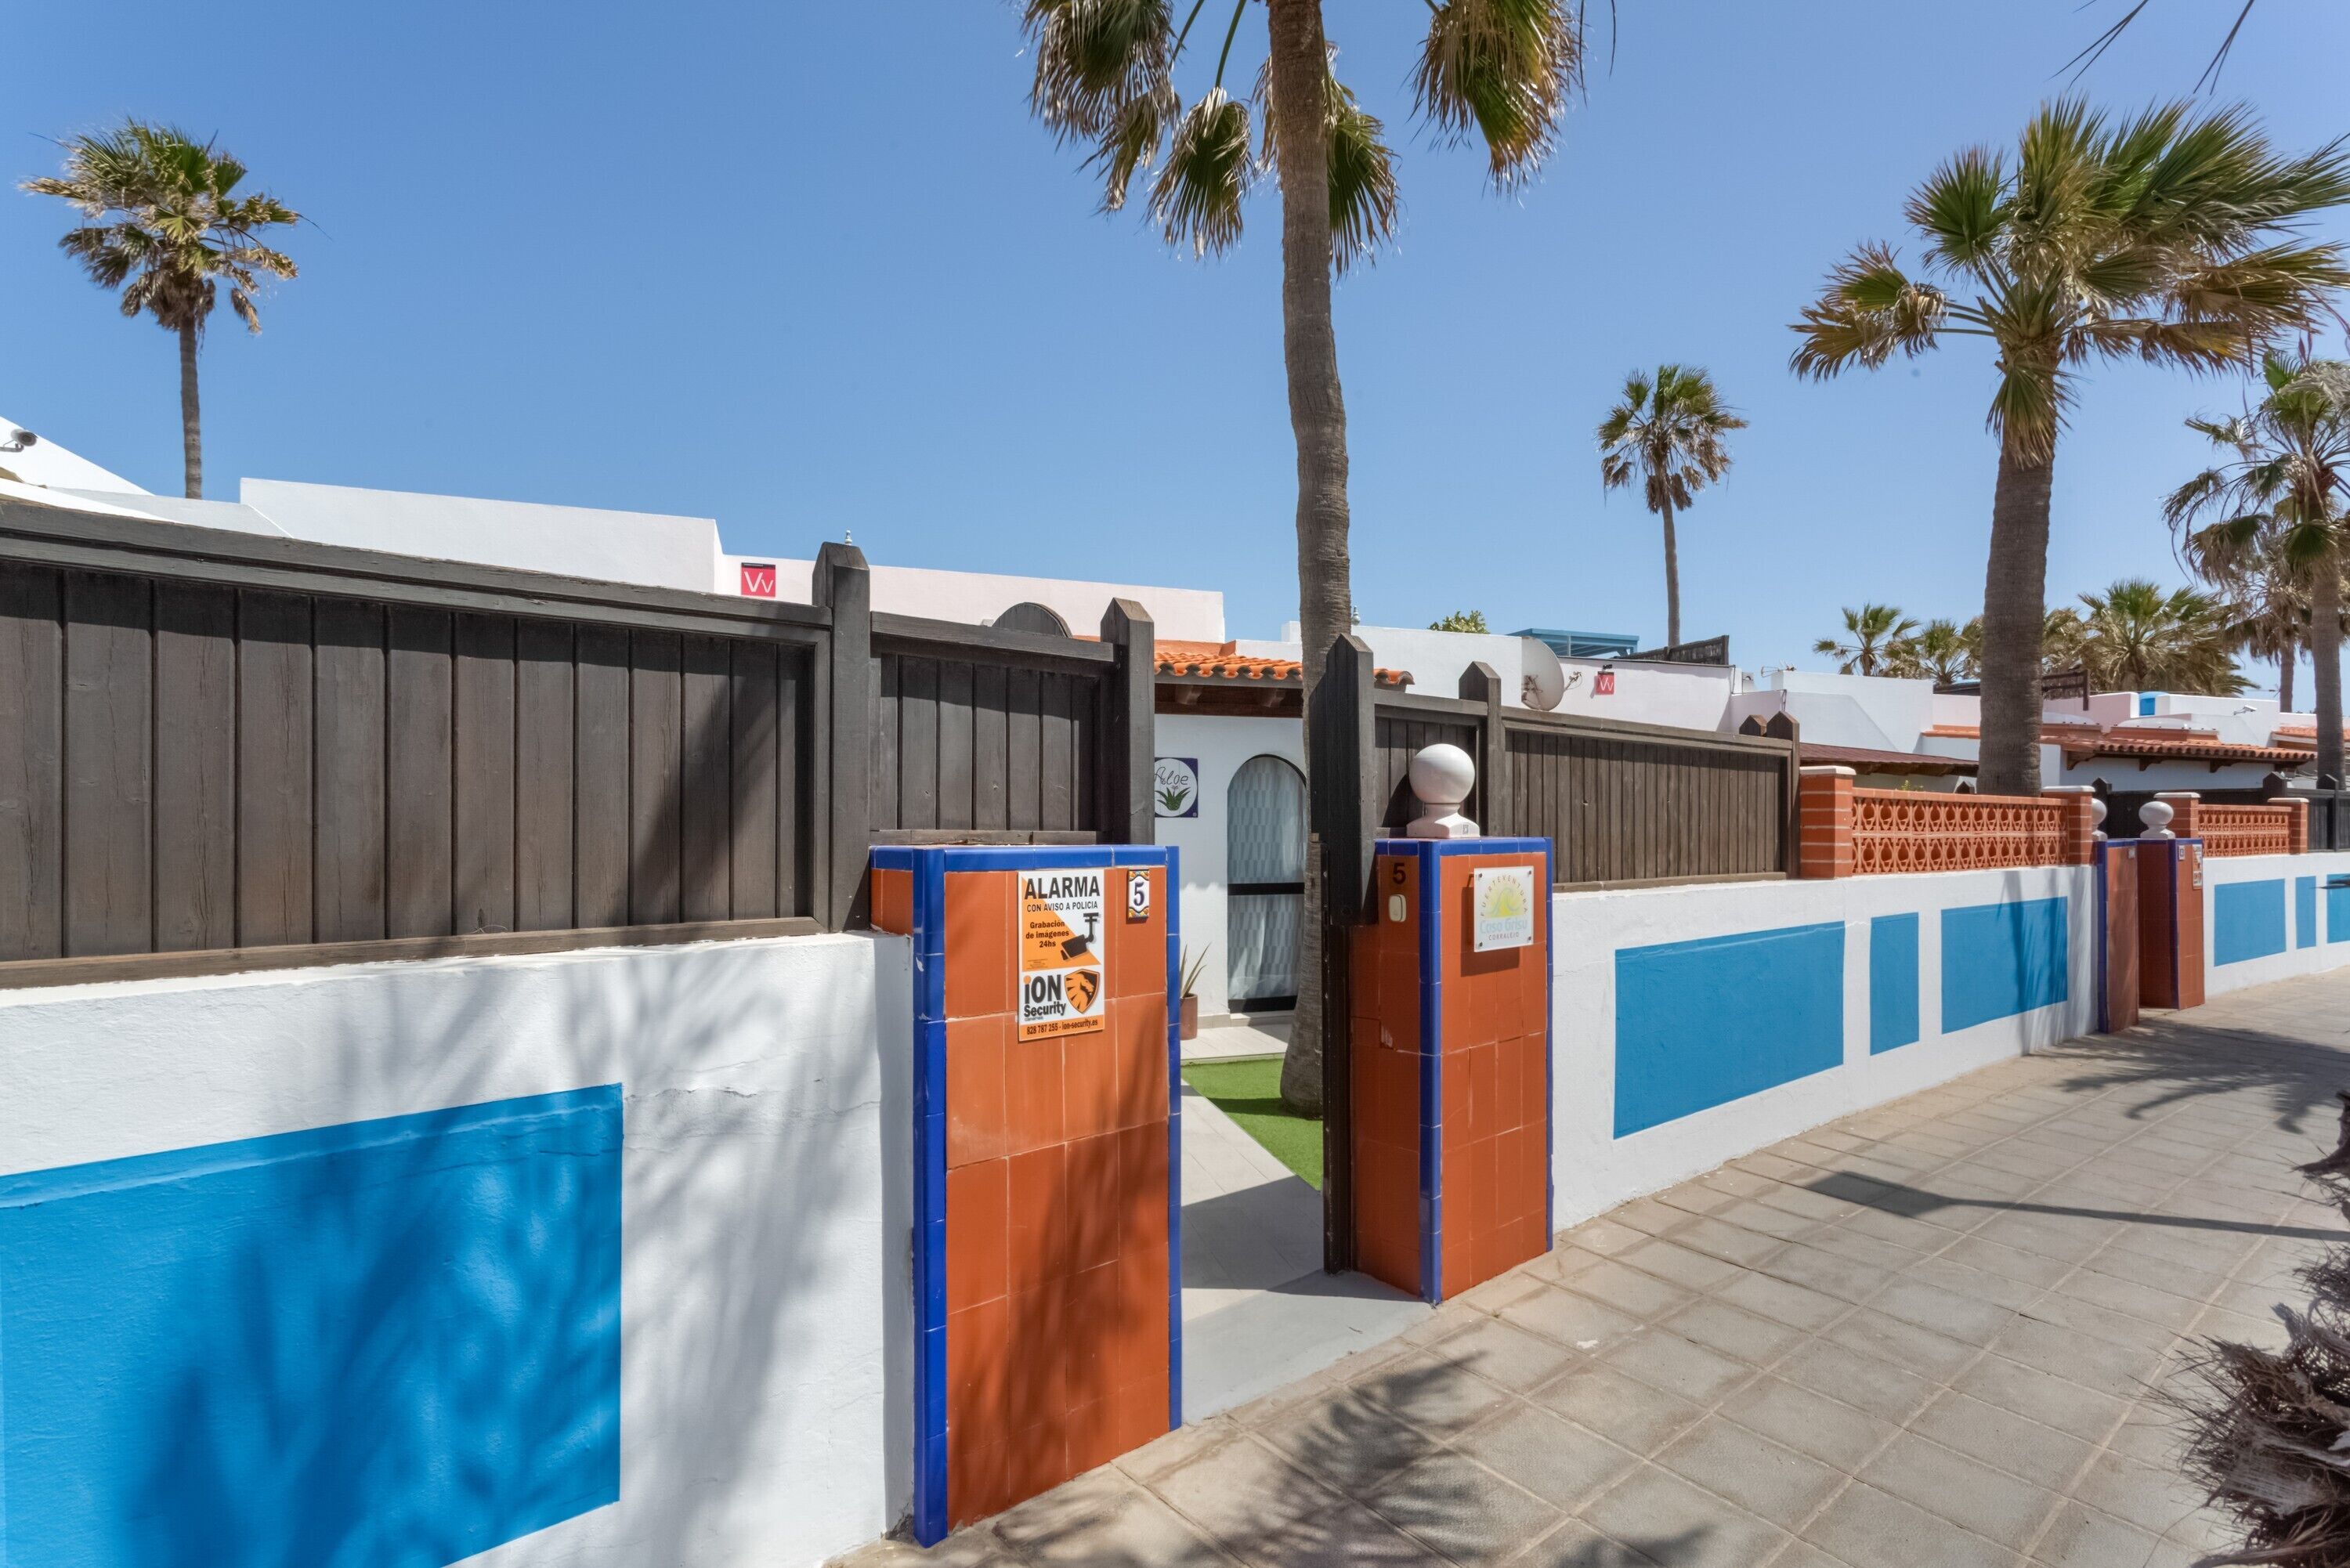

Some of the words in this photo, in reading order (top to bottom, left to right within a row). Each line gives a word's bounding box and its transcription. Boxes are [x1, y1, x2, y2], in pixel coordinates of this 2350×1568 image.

[1155, 766, 1189, 786] Aloe
[1393, 863, 1406, 884] 5
[1024, 876, 1101, 900] ALARMA
[1133, 882, 1144, 906] 5
[1027, 904, 1042, 912] CON
[1043, 902, 1064, 911] AVISO
[1072, 901, 1098, 909] POLICIA
[1029, 919, 1065, 929] Grabación
[1036, 930, 1069, 939] imágenes
[1039, 940, 1057, 948] 24hs
[1023, 1001, 1066, 1017] Security
[1038, 1024, 1047, 1033] 787
[1048, 1023, 1058, 1032] 255
[1061, 1018, 1098, 1031] ion-security.es
